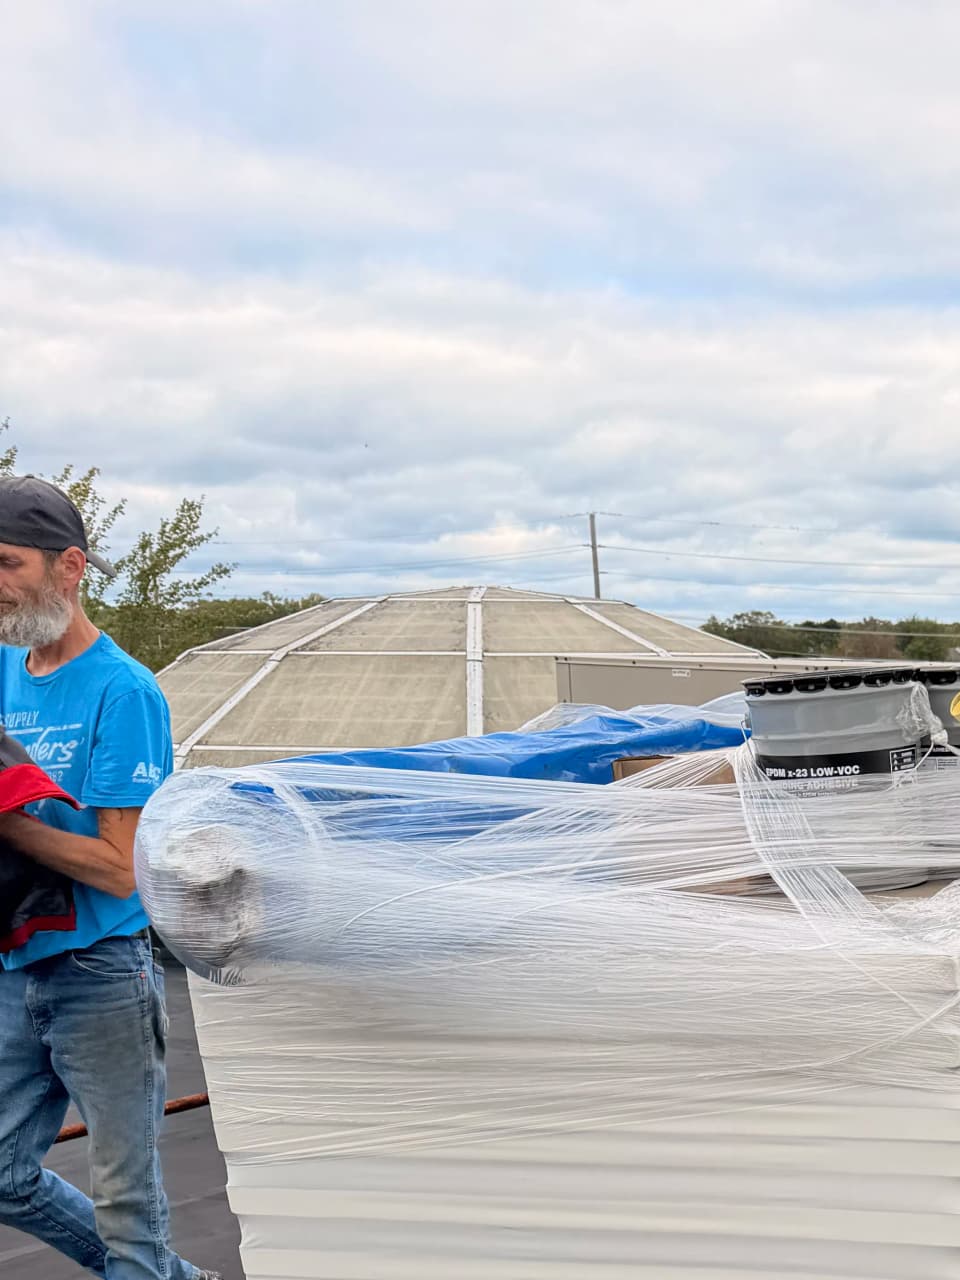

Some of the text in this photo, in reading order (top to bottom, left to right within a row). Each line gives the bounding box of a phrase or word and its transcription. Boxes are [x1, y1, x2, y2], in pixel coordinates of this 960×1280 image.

[4, 710, 40, 728] SUPPLY
[765, 767, 786, 778] EPDM
[810, 765, 860, 777] LOW-VOC
